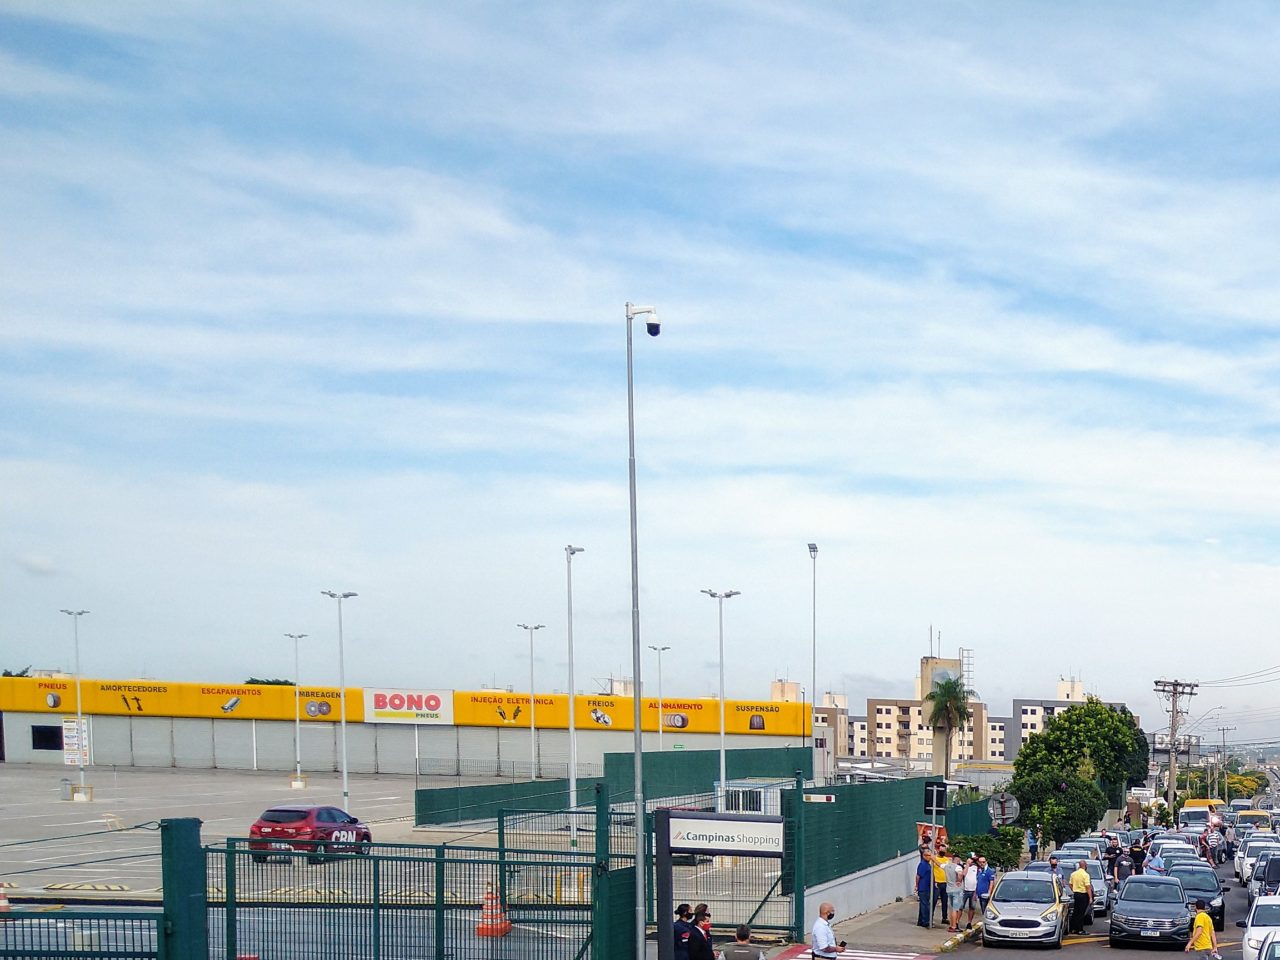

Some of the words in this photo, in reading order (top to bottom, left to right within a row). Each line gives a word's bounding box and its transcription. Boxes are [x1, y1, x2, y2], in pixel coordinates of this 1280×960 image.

[100, 685, 168, 693] AMORTECEDORES
[201, 688, 262, 696] ESCAPAMENTOS
[373, 693, 441, 711] BONO
[648, 702, 703, 710] ALNHAMENTO
[735, 705, 780, 713] SUSPENSÃO
[686, 832, 736, 844] Campinas
[736, 834, 780, 847] Shopping
